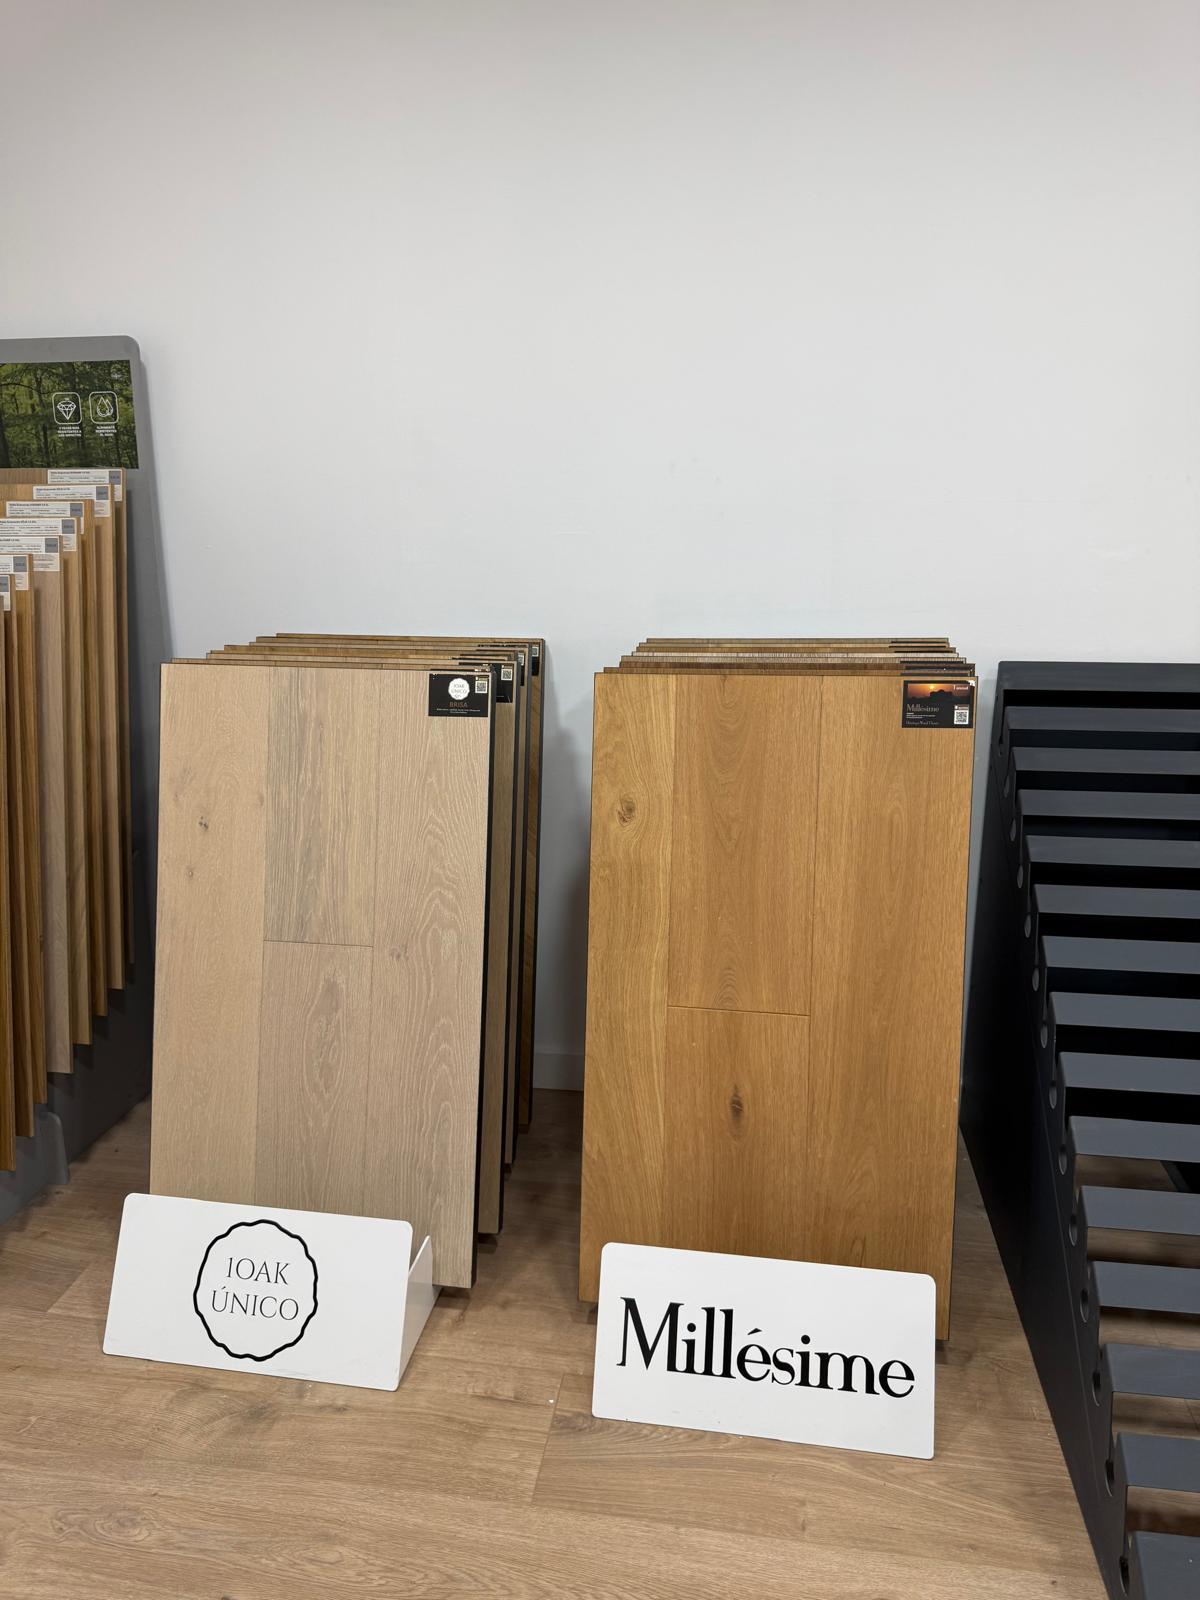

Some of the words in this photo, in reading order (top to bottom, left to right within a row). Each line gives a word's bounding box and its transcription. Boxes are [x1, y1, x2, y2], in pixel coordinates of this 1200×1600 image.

[226, 1256, 290, 1285] 1OAK
[211, 1285, 299, 1321] ÚNICO
[616, 1296, 915, 1399] Millésime
